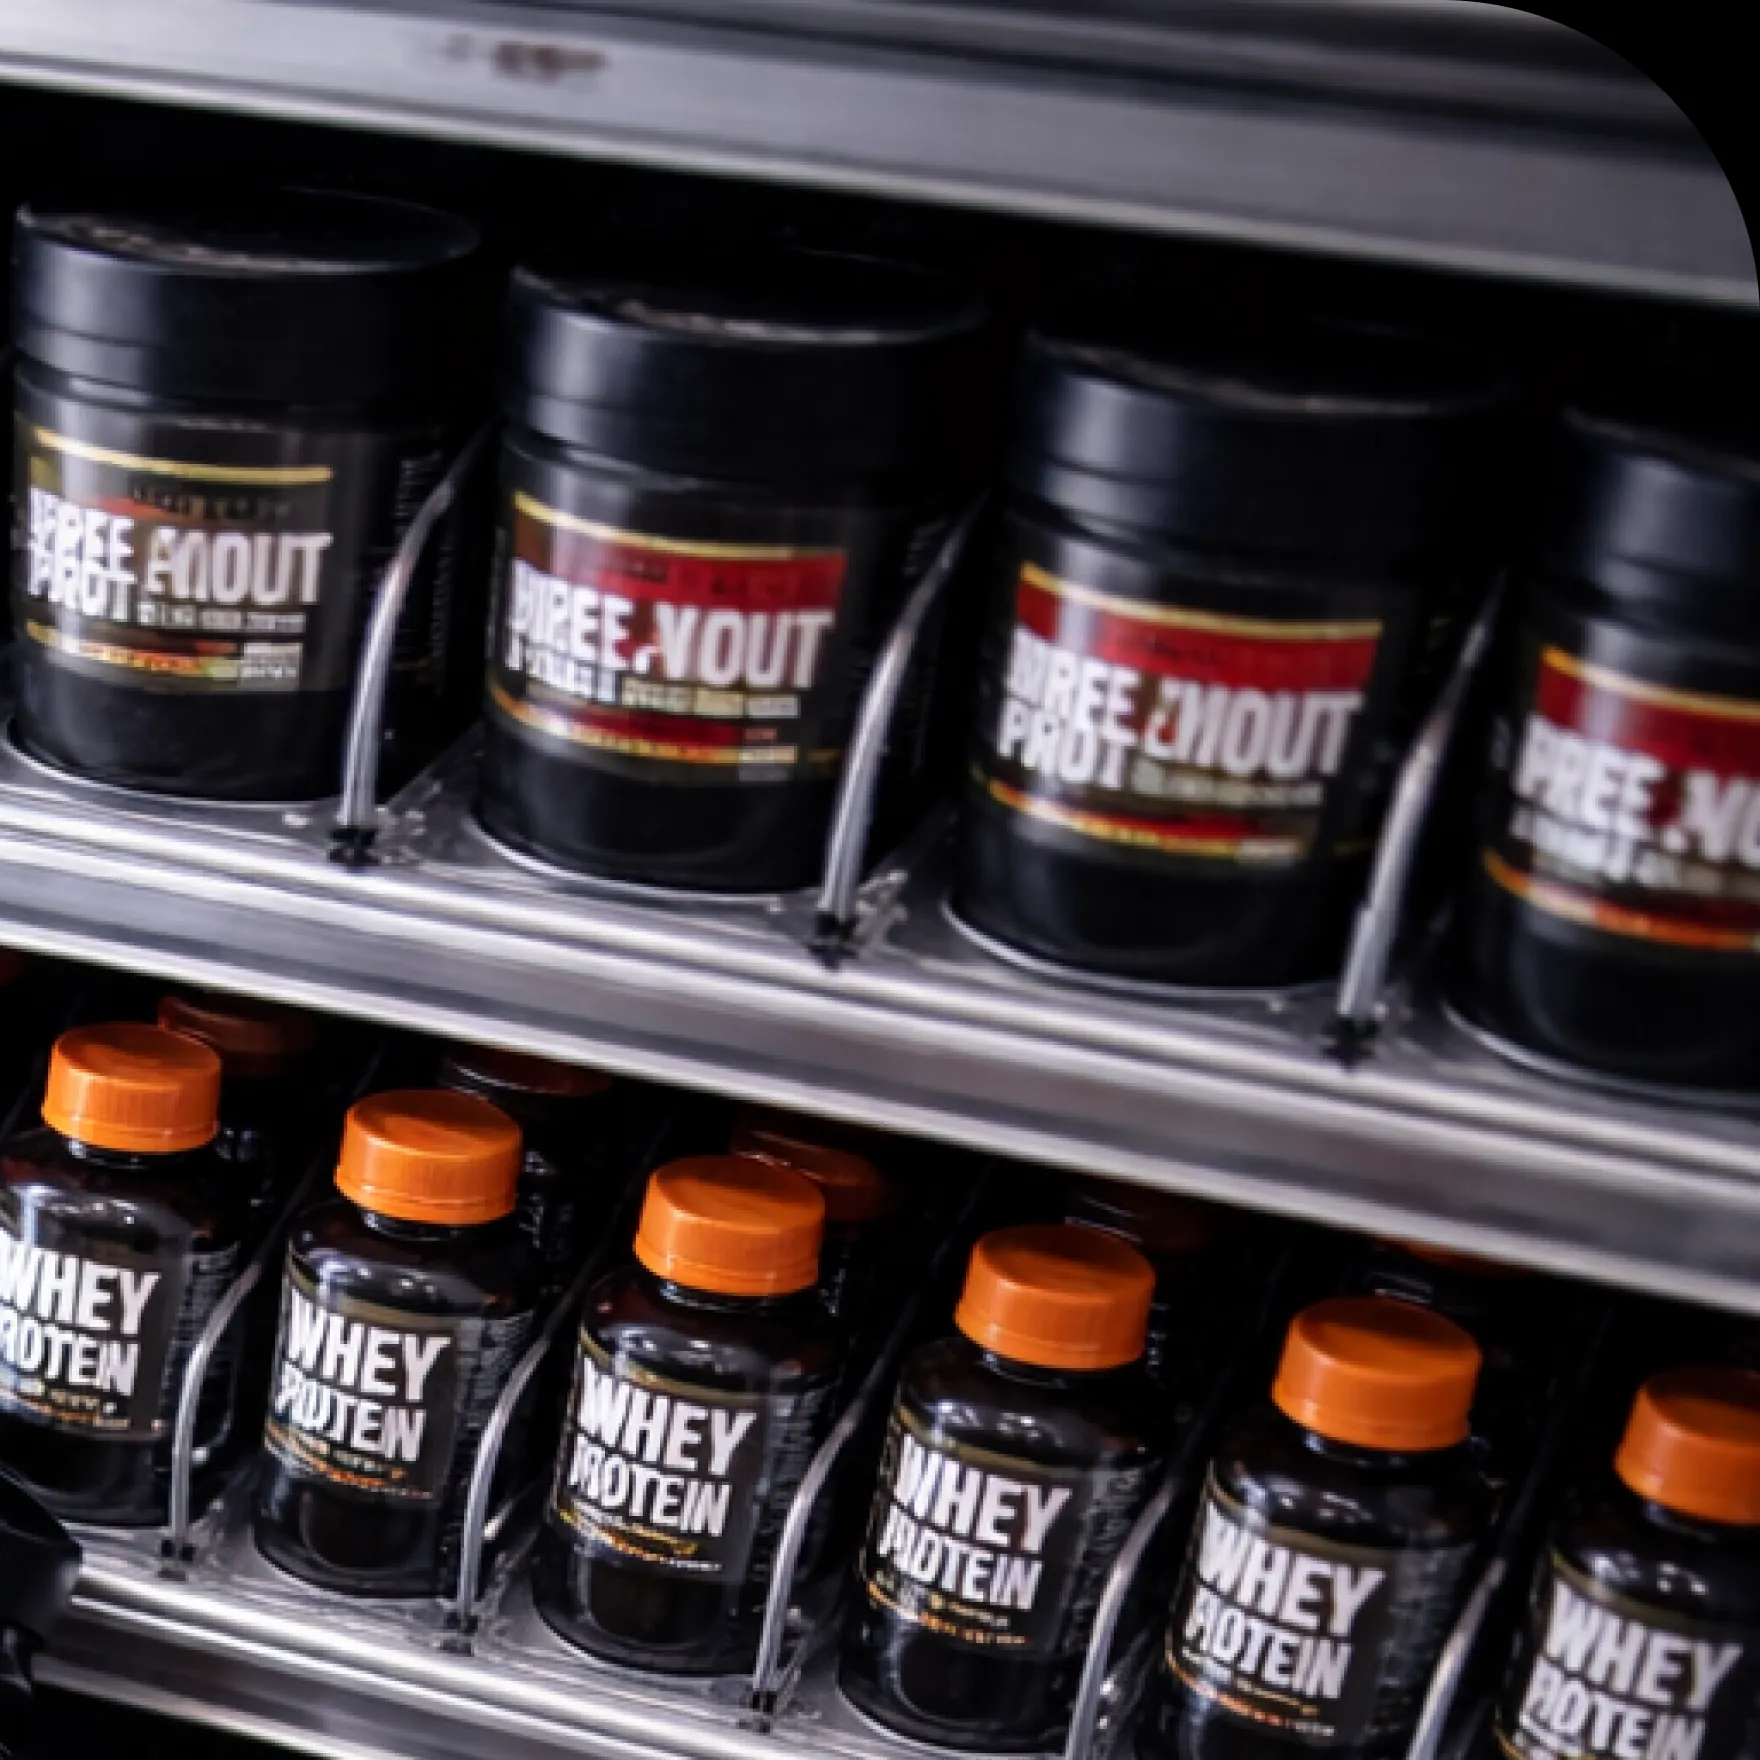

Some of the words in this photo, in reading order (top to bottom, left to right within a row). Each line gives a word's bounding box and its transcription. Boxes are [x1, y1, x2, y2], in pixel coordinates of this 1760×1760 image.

[288, 1287, 452, 1402] WHEY
[579, 1355, 757, 1476] WHEY
[893, 1433, 1073, 1551] WHEY
[1197, 1500, 1386, 1637] WHEY
[1543, 1578, 1745, 1711] WHEY
